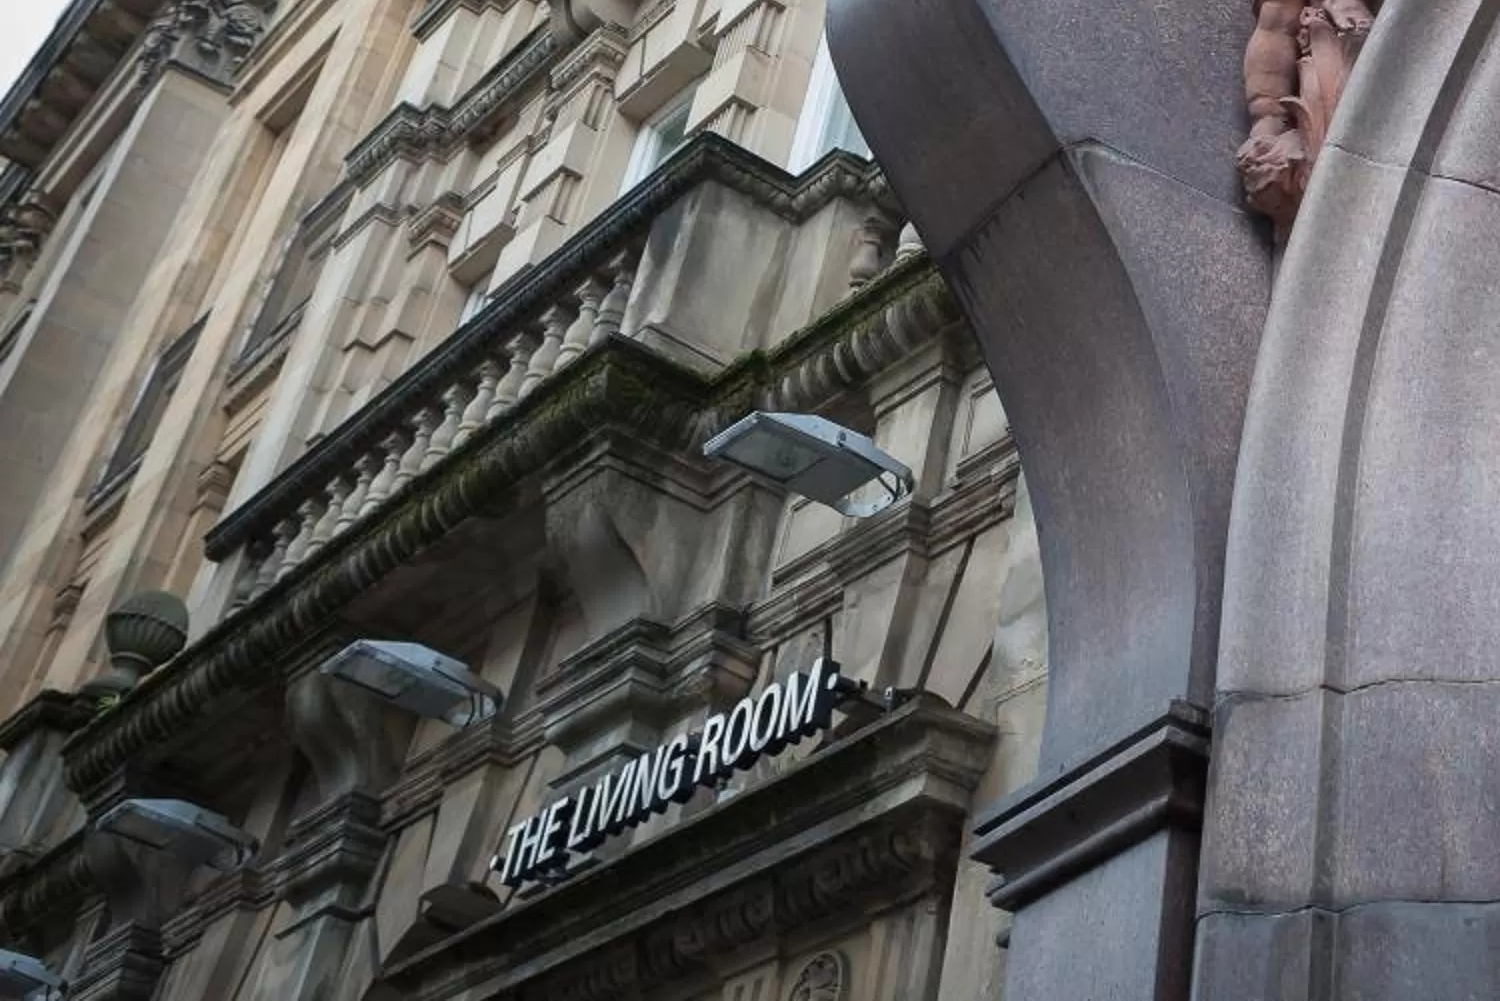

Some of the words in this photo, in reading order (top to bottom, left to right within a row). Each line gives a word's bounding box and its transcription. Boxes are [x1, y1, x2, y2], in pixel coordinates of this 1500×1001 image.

[502, 797, 569, 884] THE
[567, 734, 688, 848] LIVING
[694, 656, 823, 782] ROOM
